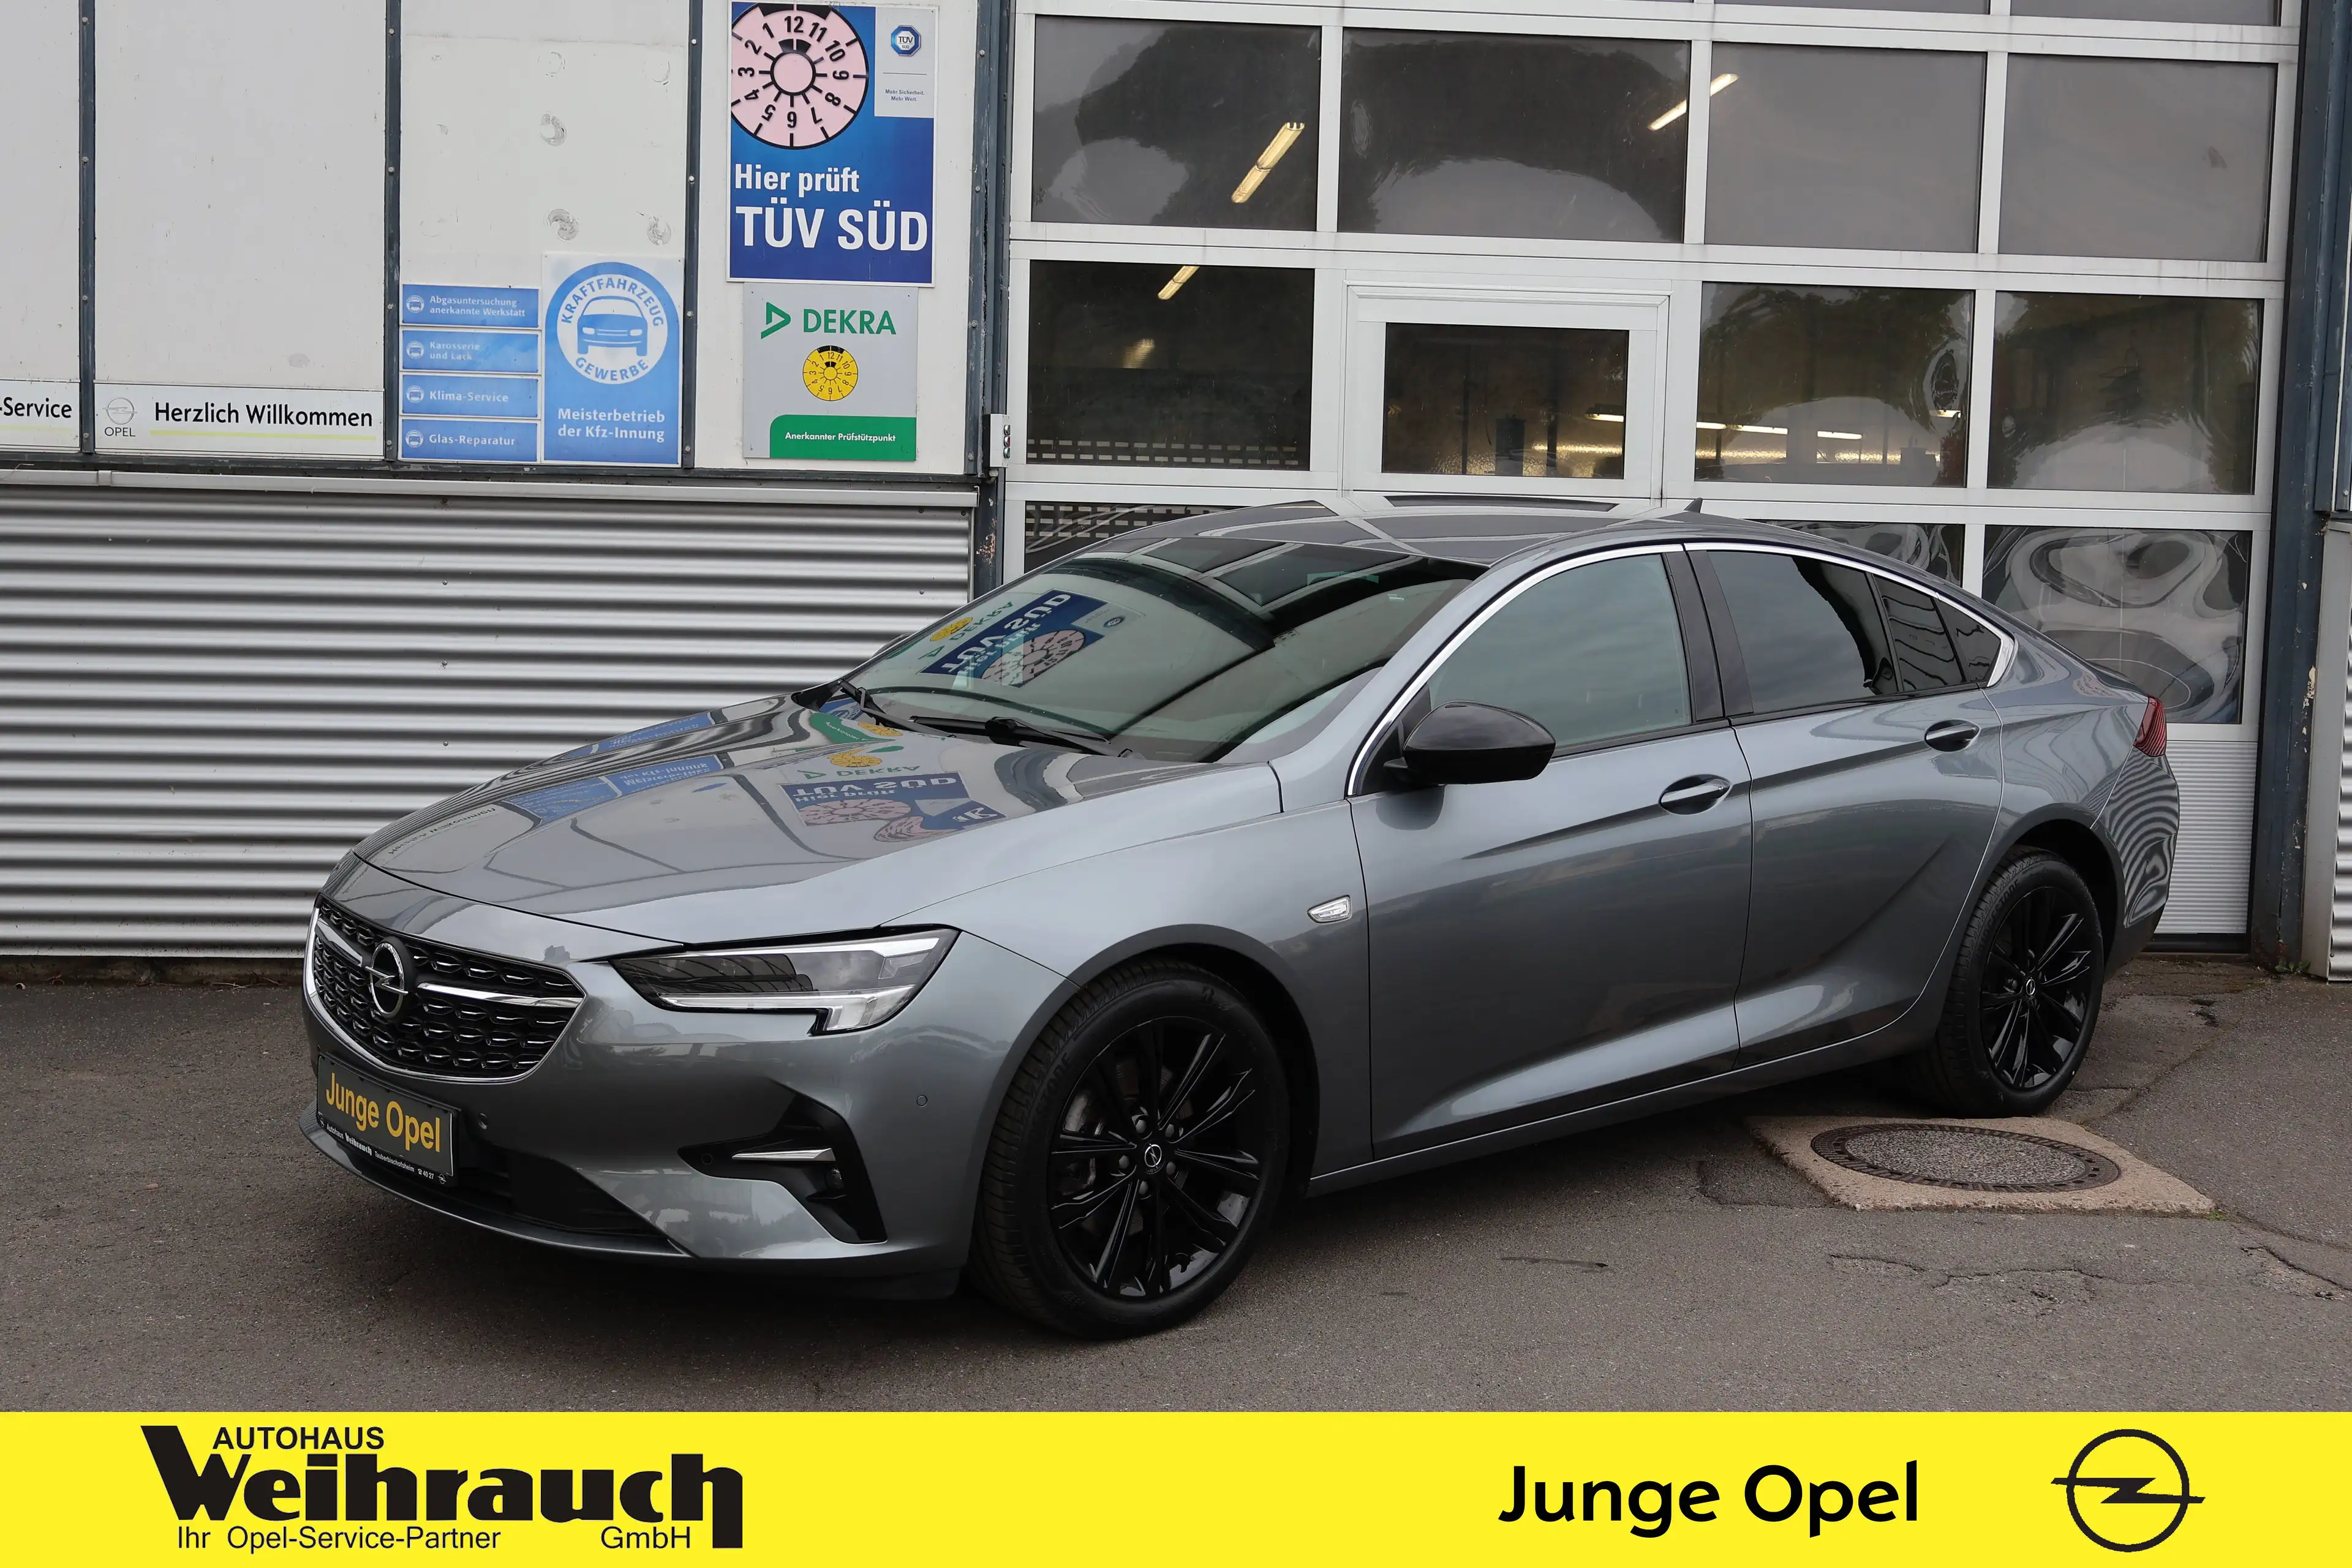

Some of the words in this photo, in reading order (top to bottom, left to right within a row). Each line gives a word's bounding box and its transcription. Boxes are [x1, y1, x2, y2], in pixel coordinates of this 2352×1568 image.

[762, 22, 775, 39] 1
[784, 15, 804, 33] 12
[809, 22, 827, 42] 11
[744, 39, 762, 55] 2
[825, 40, 846, 62] 10
[737, 67, 755, 77] 3
[832, 70, 850, 80] 9
[744, 89, 760, 100] 4
[824, 92, 842, 106] 8
[761, 104, 776, 121] 5
[786, 111, 797, 128] 6
[810, 107, 823, 124] 7
[735, 164, 791, 190] Hier
[799, 167, 860, 198] prüft
[736, 197, 825, 248] TÜV
[837, 200, 928, 251] SÜD
[429, 296, 517, 308] Abgasuntersuchung
[560, 277, 665, 328] KRAFTFAHRZEUG
[430, 307, 480, 315] anerkannte
[483, 308, 526, 317] Werkstatt
[803, 309, 897, 335] DEKRA
[430, 341, 481, 350] Karosserie
[451, 352, 473, 361] Lack
[842, 361, 850, 369] 10
[575, 356, 649, 382] GEWERBE
[429, 391, 509, 403] Klima-Service
[154, 402, 239, 423] Herzlich
[246, 404, 372, 427] Willkommen
[558, 408, 665, 423] Meisterbetrieb
[104, 427, 136, 437] OPEL
[429, 434, 515, 447] Glas-Reparatur
[558, 424, 581, 437] der
[586, 426, 665, 443] Kfz-Innung
[785, 432, 836, 441] Anerkannter
[838, 432, 896, 443] Prüfstützpunkt
[326, 1072, 379, 1131] Junge
[386, 1101, 441, 1153] Opel
[326, 1123, 344, 1139] Autohaus
[344, 1132, 372, 1156] Weihrauch
[374, 1150, 415, 1172] Tauberbischofsheim
